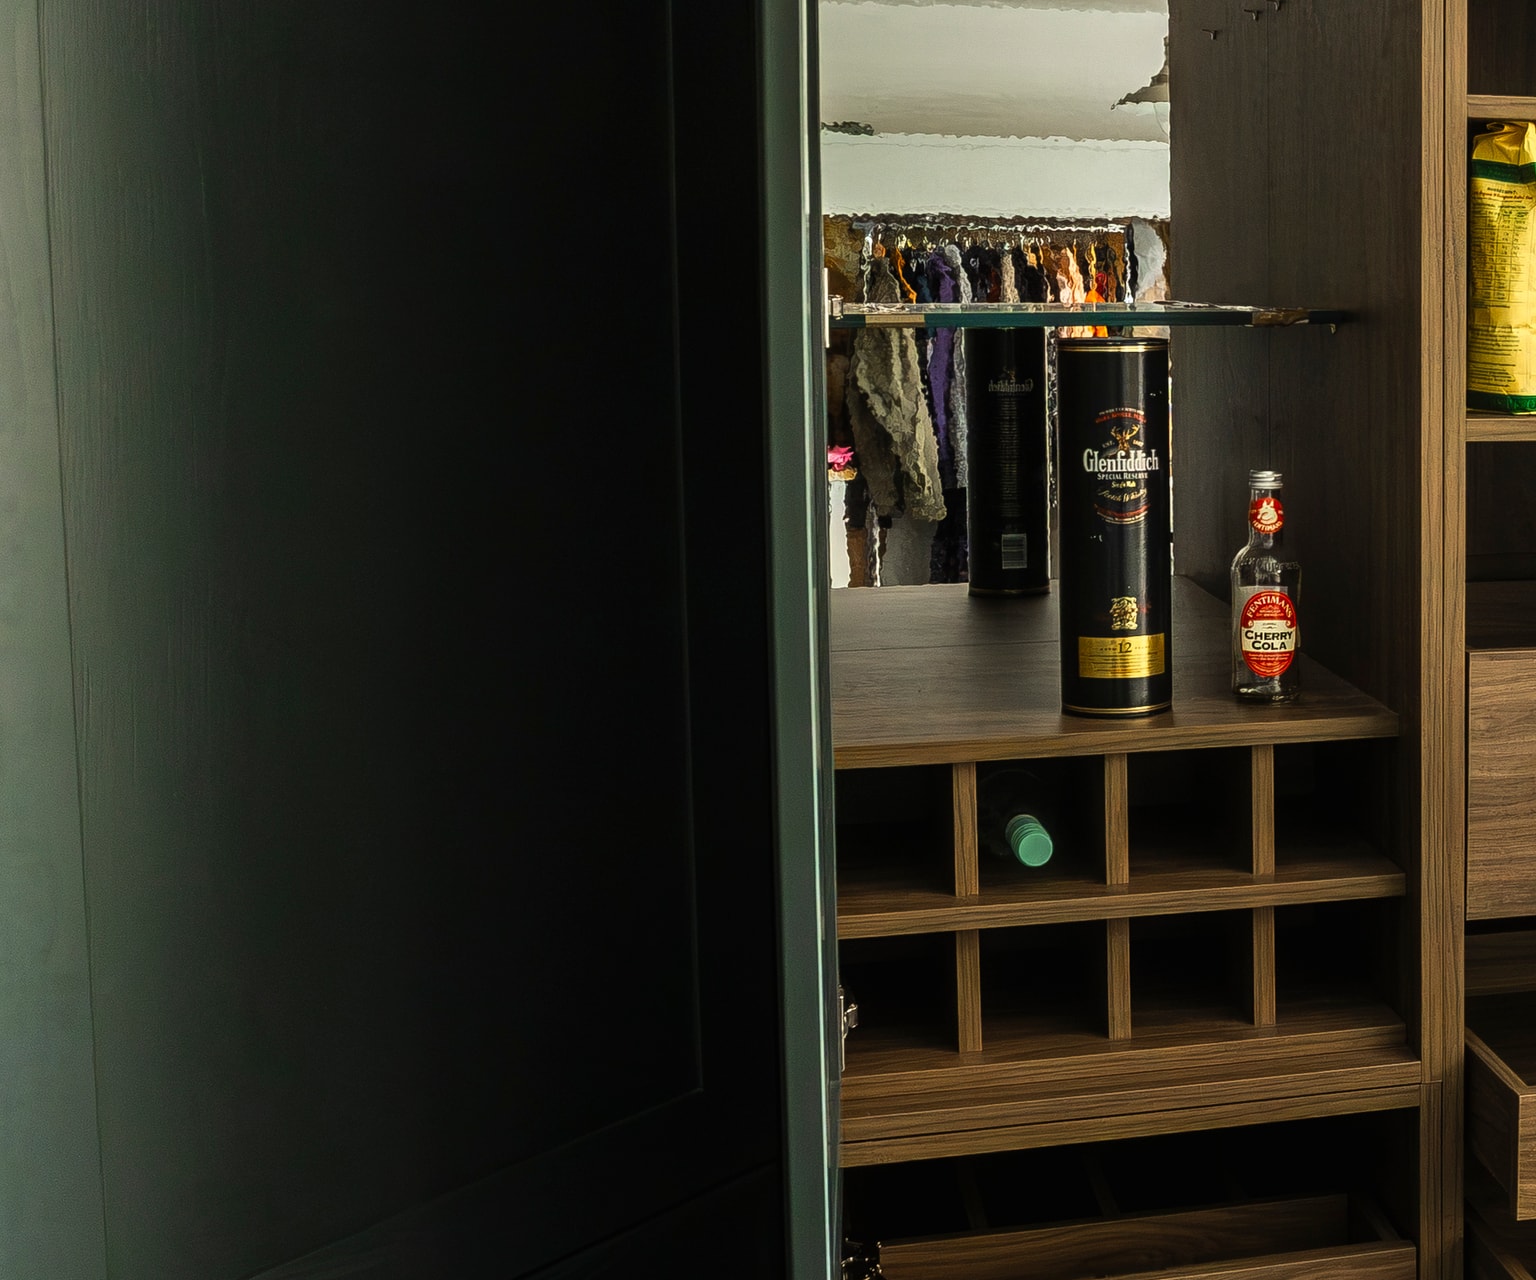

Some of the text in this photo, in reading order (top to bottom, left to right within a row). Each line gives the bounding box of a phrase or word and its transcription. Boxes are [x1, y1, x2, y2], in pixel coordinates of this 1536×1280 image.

[1083, 448, 1159, 472] Glenfiddich
[1097, 472, 1121, 480] SPECIAL
[1246, 595, 1293, 618] FENTIMANS
[1245, 630, 1293, 641] CHERRY
[1118, 642, 1132, 654] 12
[1251, 641, 1287, 651] COLA
